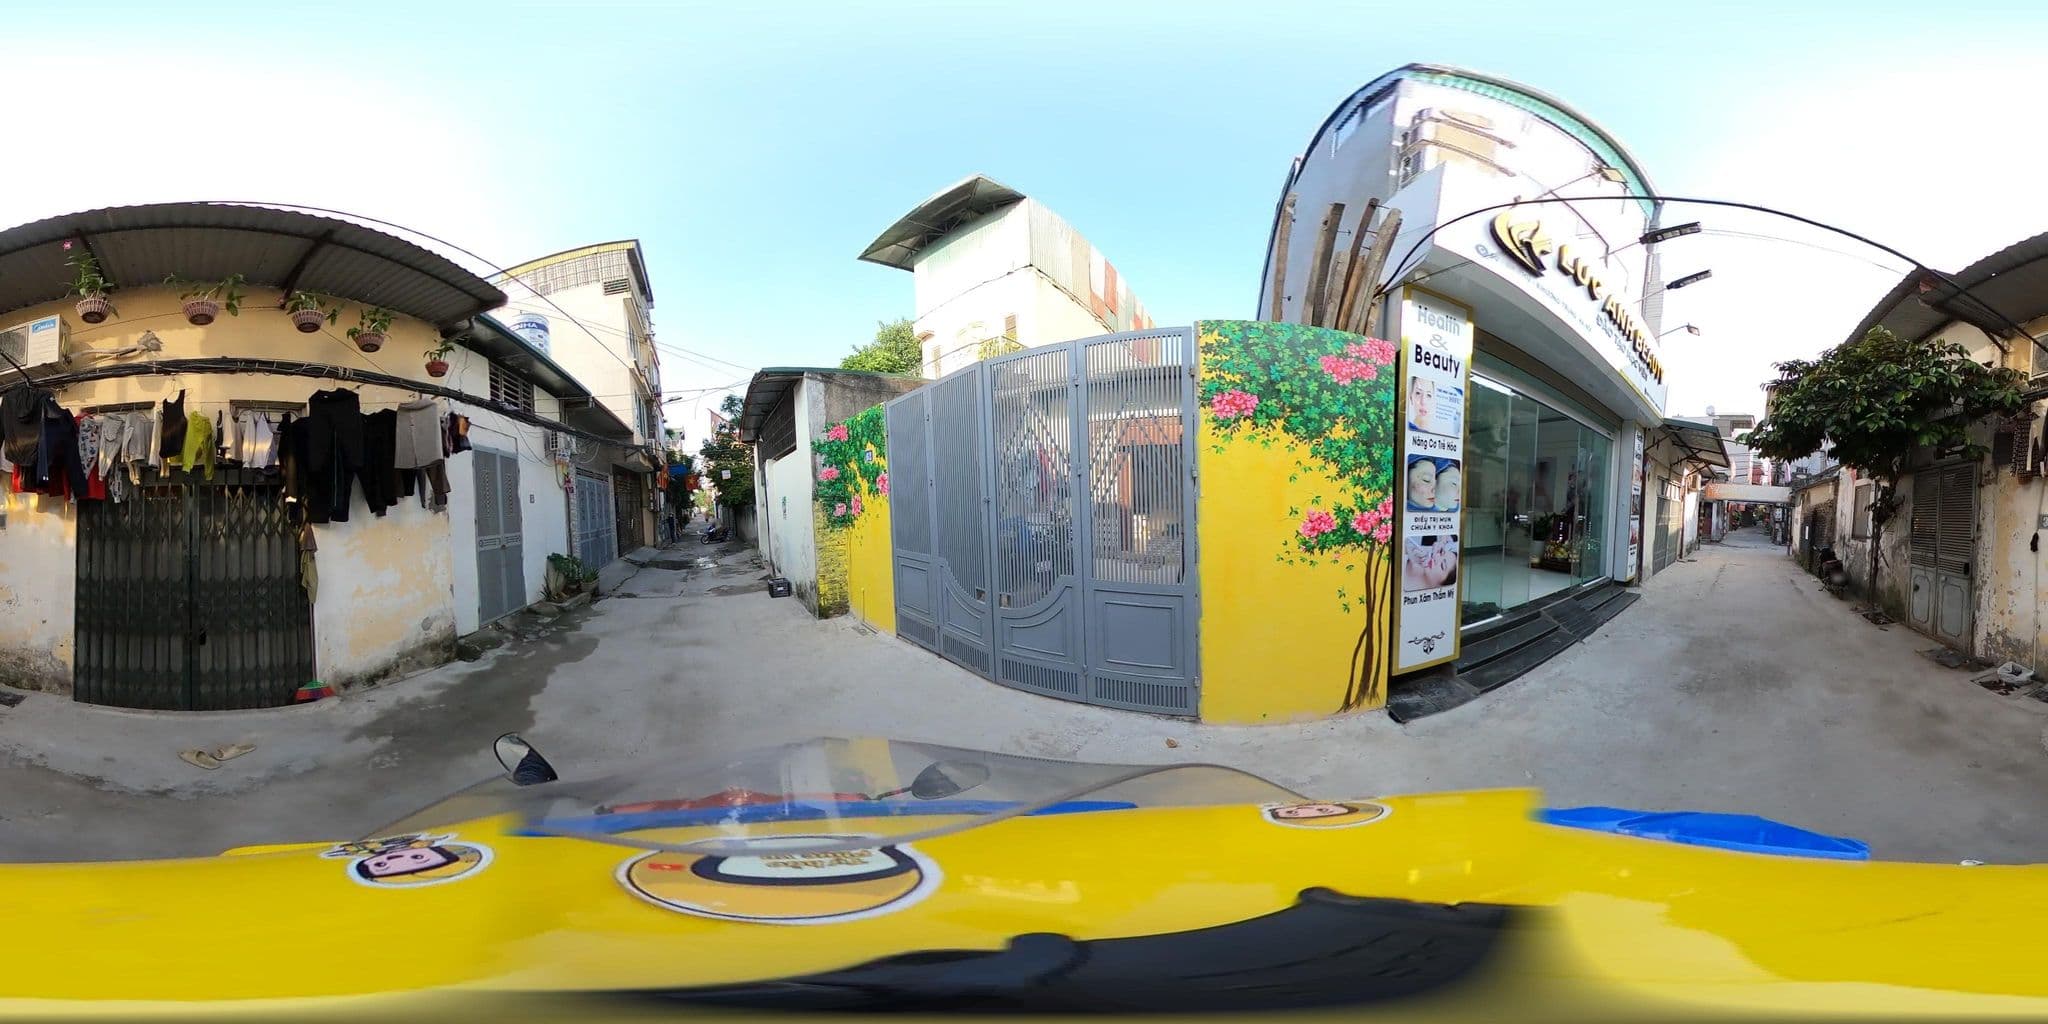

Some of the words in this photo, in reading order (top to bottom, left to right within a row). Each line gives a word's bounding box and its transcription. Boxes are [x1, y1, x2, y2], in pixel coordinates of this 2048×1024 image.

[1417, 305, 1460, 336] Health
[1429, 334, 1448, 351] &
[1415, 344, 1460, 378] Beauty
[1403, 596, 1418, 605] Phun
